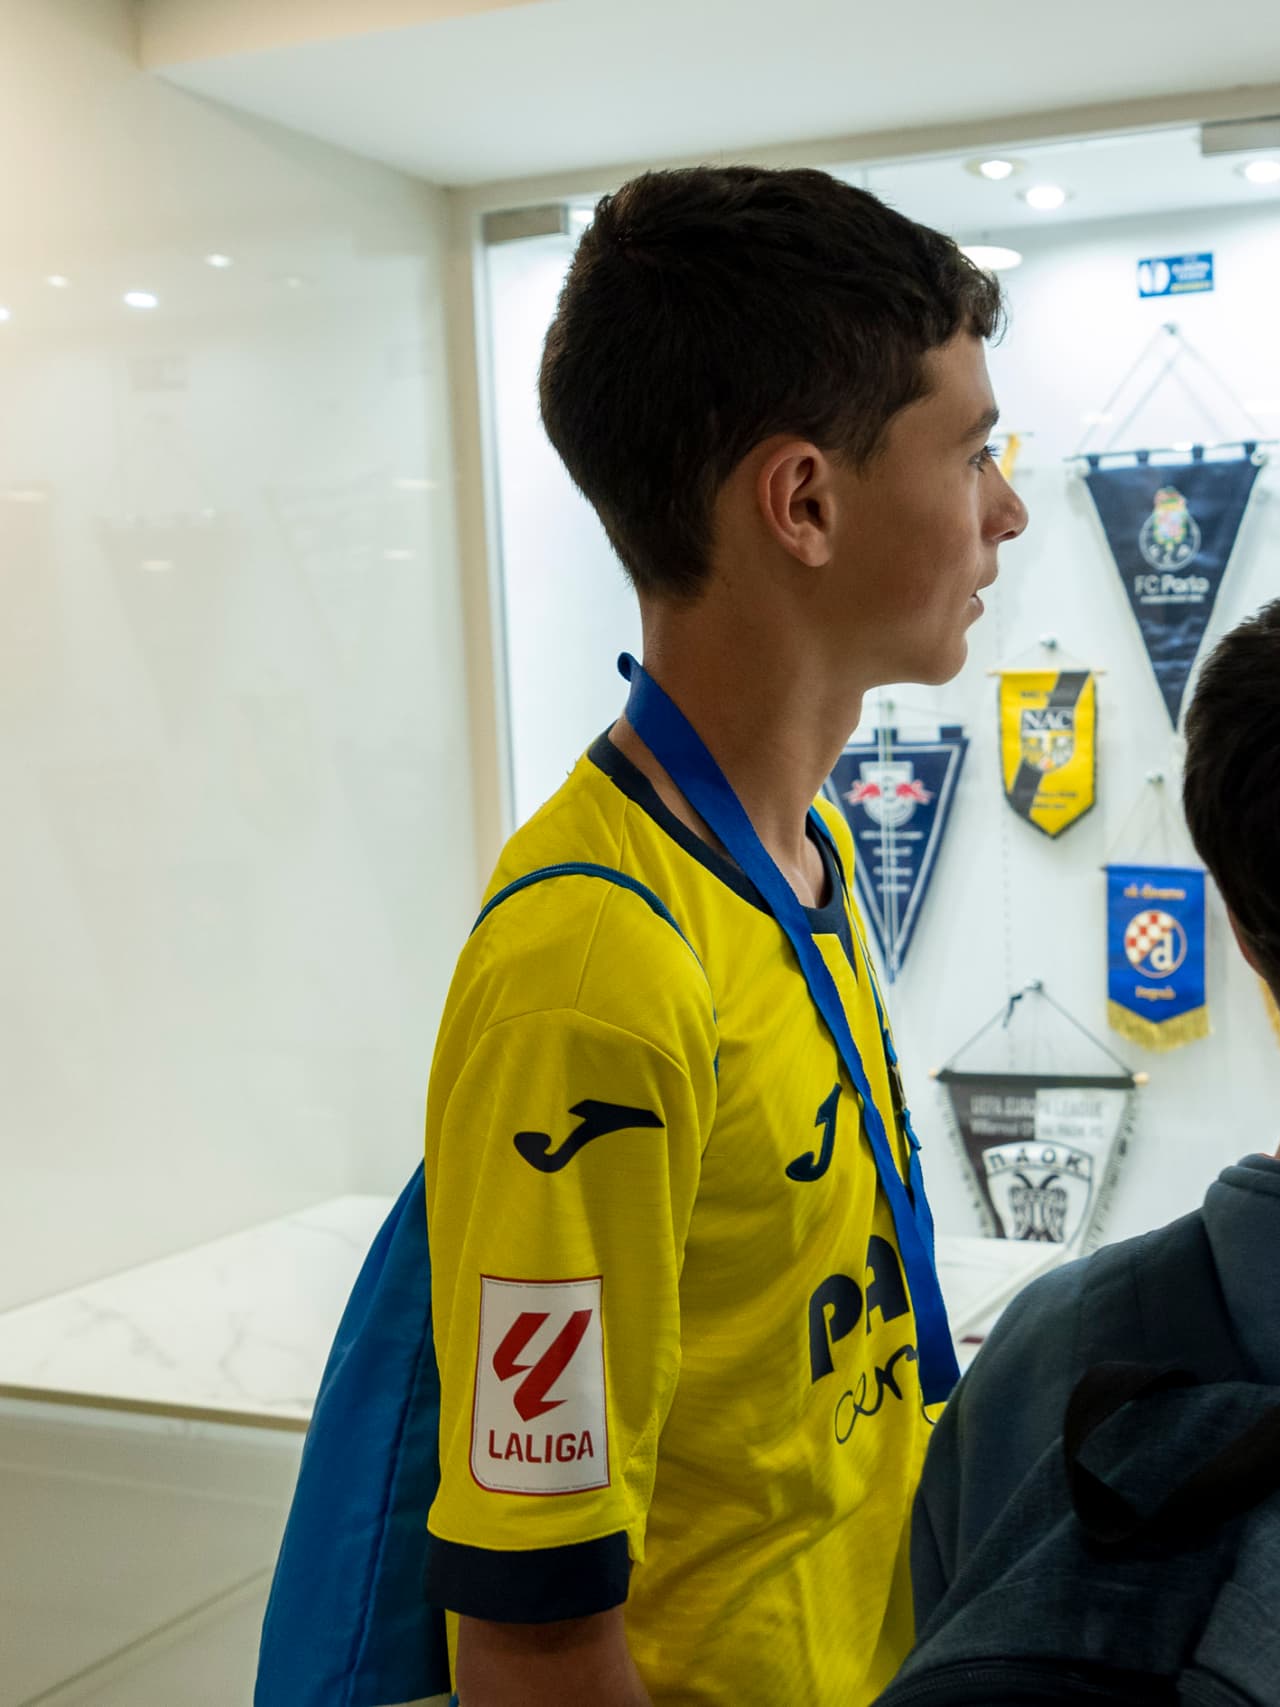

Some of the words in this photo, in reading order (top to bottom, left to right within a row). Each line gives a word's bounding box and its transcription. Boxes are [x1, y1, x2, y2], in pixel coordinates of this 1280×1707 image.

[1135, 574, 1159, 595] FC
[1161, 574, 1210, 593] Porto
[1022, 710, 1073, 729] NAC
[488, 1429, 594, 1464] LALIGA
